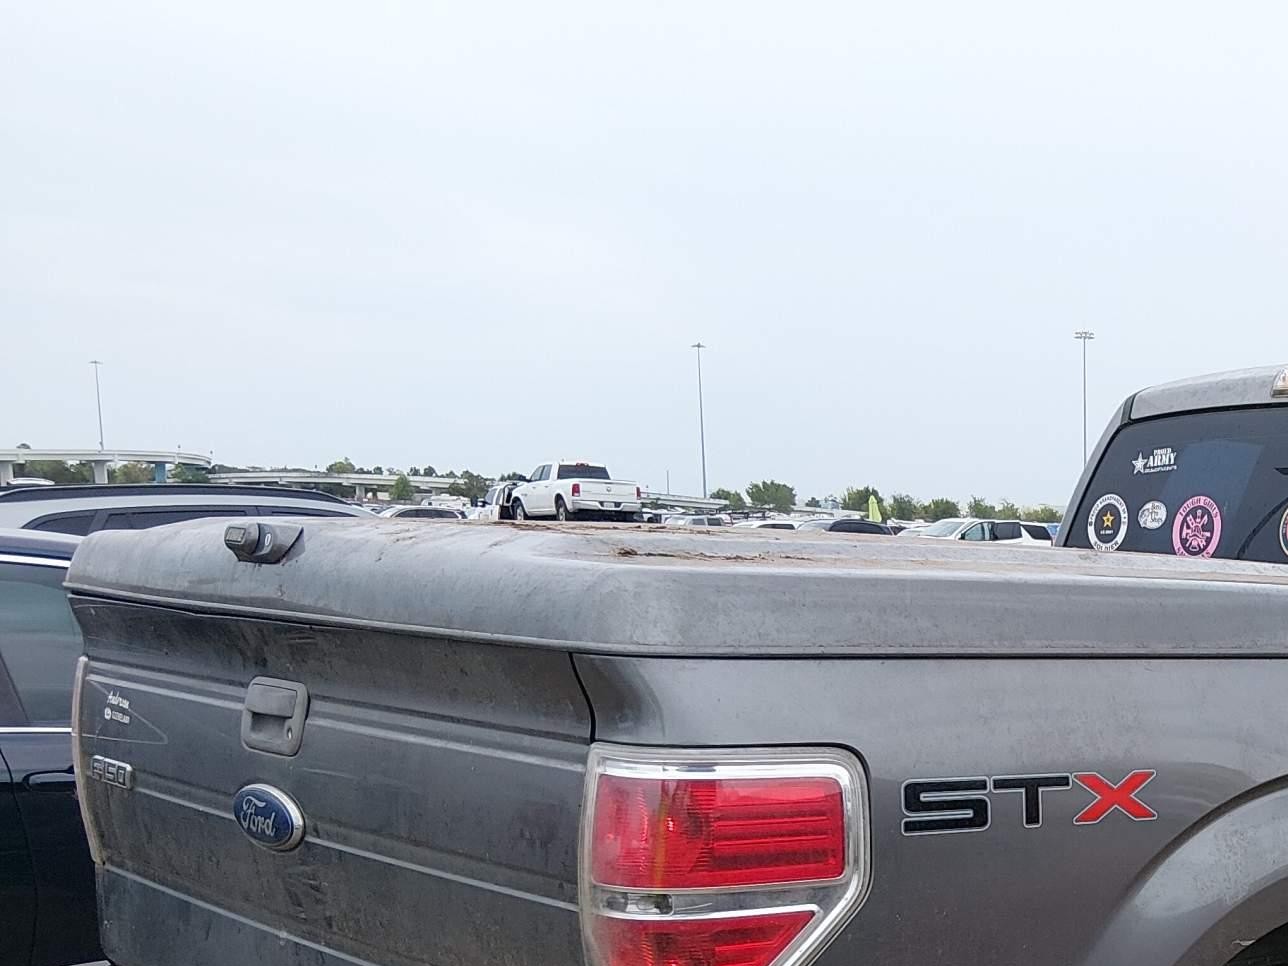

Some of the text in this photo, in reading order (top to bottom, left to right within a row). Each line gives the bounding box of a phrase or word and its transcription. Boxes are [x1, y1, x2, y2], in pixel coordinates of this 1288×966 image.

[1146, 451, 1177, 468] ARMY
[240, 795, 276, 837] Ford
[901, 769, 1158, 836] STX
